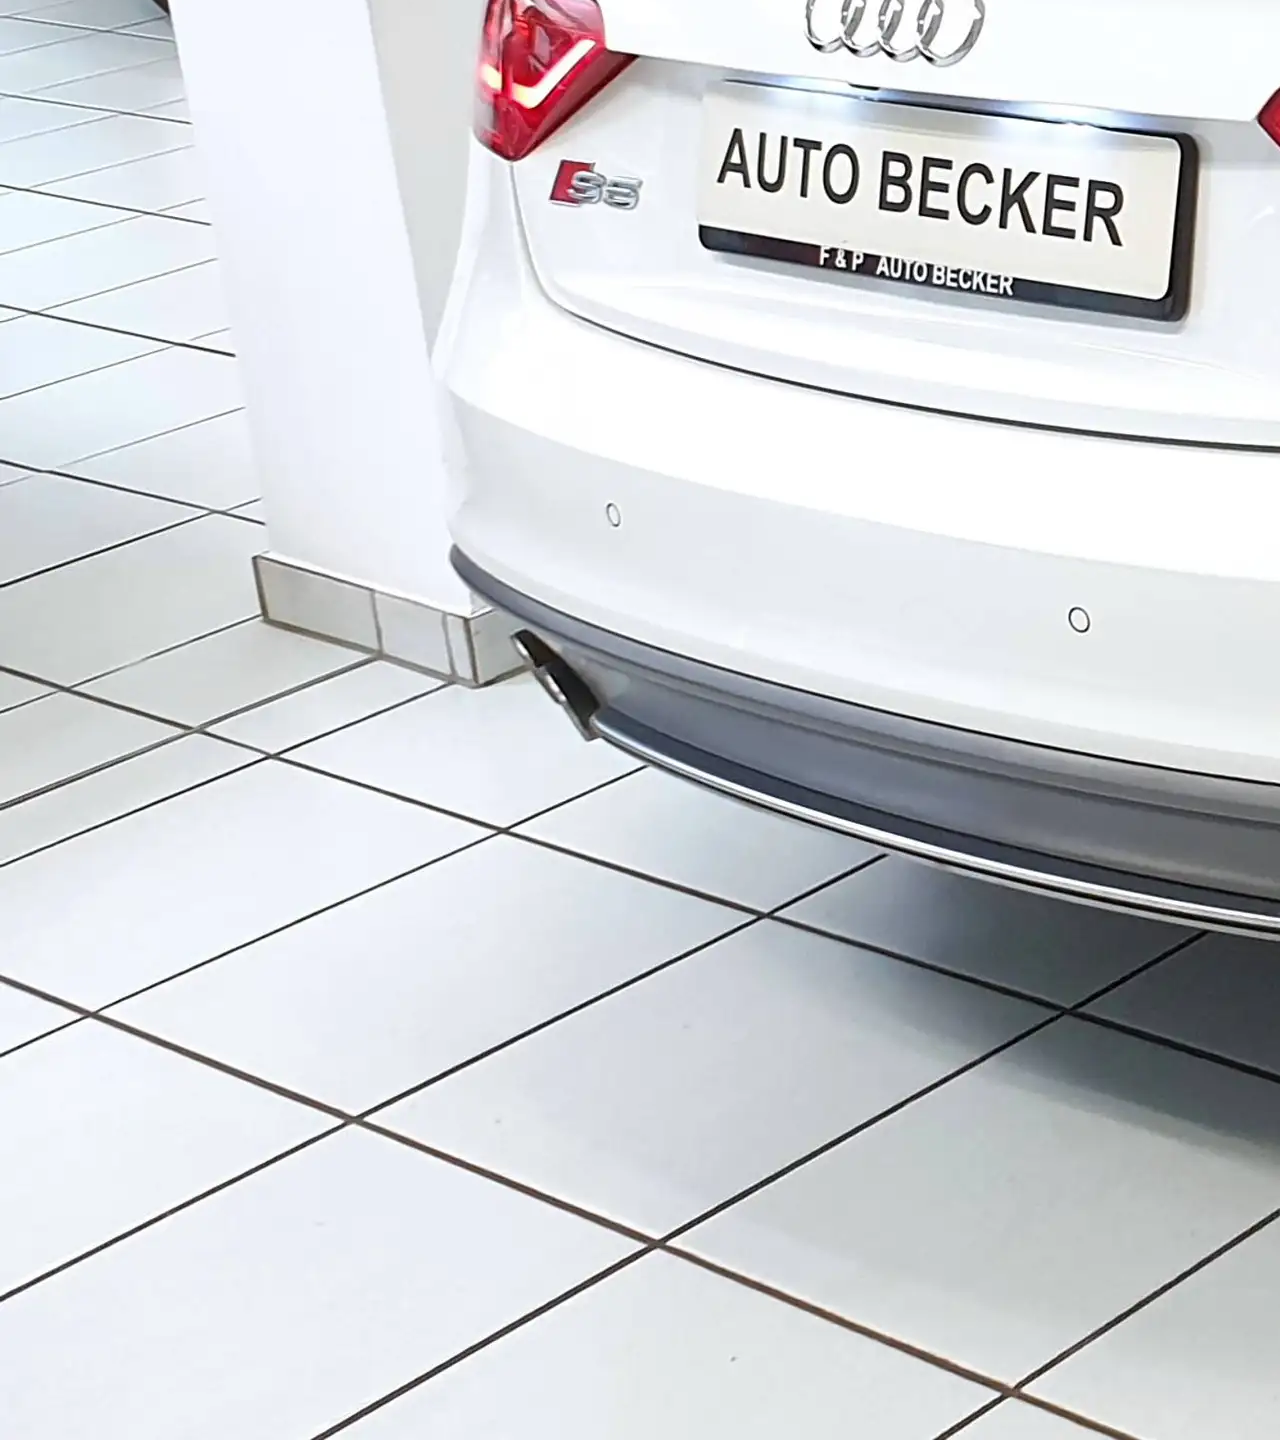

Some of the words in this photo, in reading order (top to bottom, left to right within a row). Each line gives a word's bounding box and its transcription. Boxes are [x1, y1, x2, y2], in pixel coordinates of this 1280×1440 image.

[557, 164, 644, 210] S5
[716, 127, 860, 205] AUTO
[878, 150, 1125, 247] BECKER
[819, 245, 831, 266] F
[835, 248, 847, 269] &
[851, 251, 864, 271] P
[876, 256, 928, 283] AUTO
[931, 264, 1014, 296] BECKER
